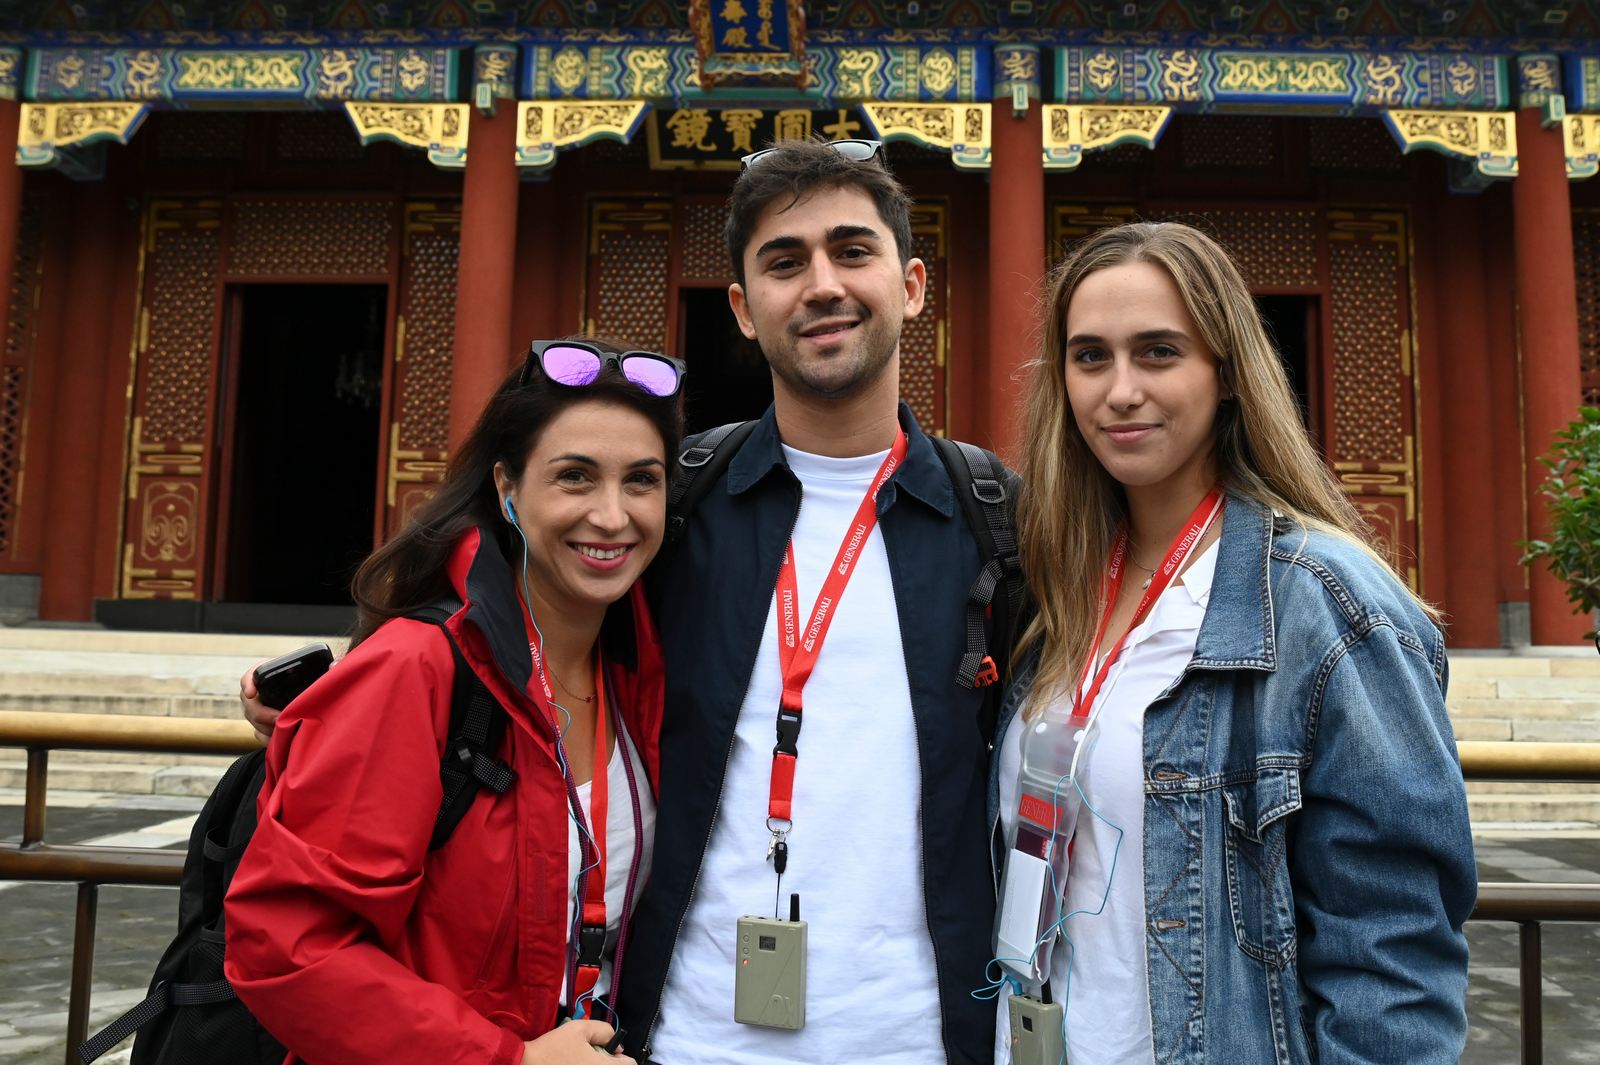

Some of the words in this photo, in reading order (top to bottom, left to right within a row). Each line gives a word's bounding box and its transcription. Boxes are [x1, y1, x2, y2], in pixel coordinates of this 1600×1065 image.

[843, 524, 866, 562] GENERALI
[1171, 524, 1201, 565] GENERALI
[783, 590, 793, 633] GENERALI
[809, 597, 832, 639] GENERALI
[529, 641, 547, 686] GEERALI
